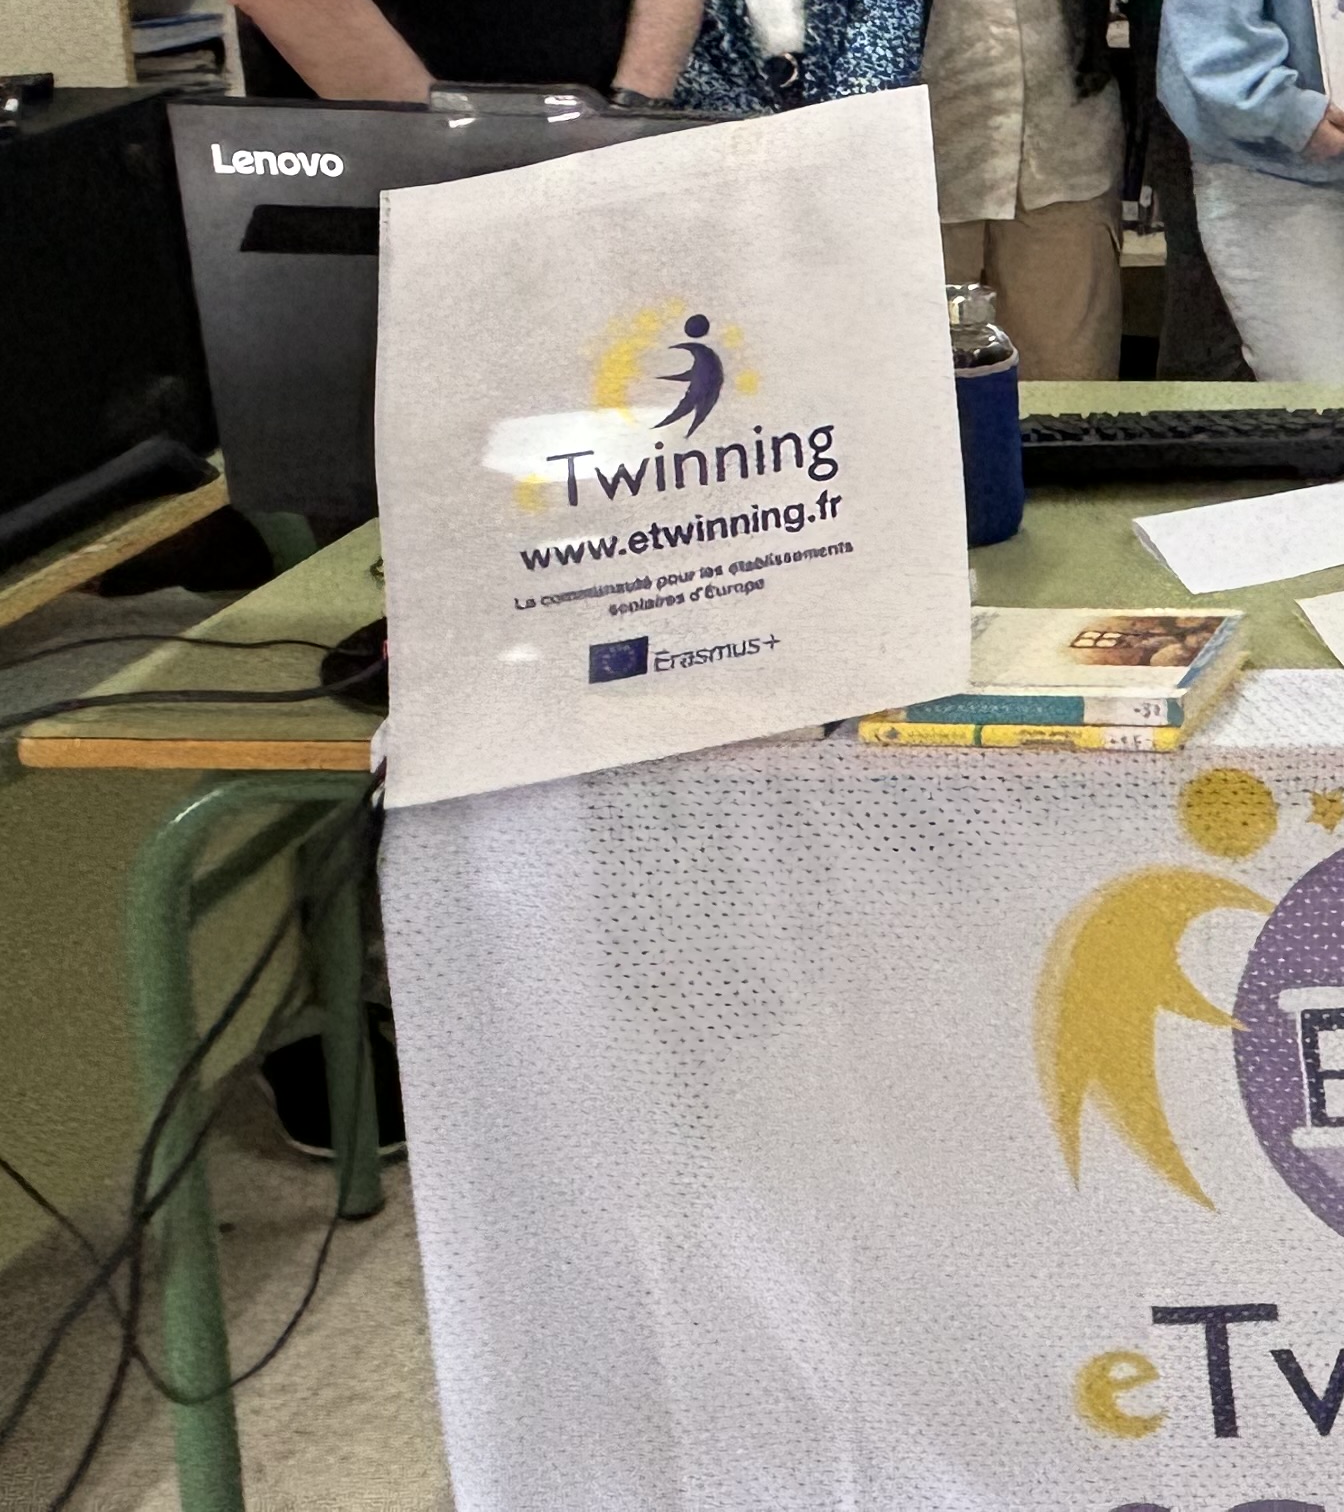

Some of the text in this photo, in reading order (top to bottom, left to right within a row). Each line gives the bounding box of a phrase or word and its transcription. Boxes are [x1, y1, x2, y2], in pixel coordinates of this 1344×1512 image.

[210, 143, 344, 178] Lenovo
[514, 425, 840, 509] Twinning
[520, 489, 843, 571] www.etwinning.fr
[656, 569, 696, 591] pour
[653, 633, 782, 673] Erasmus+
